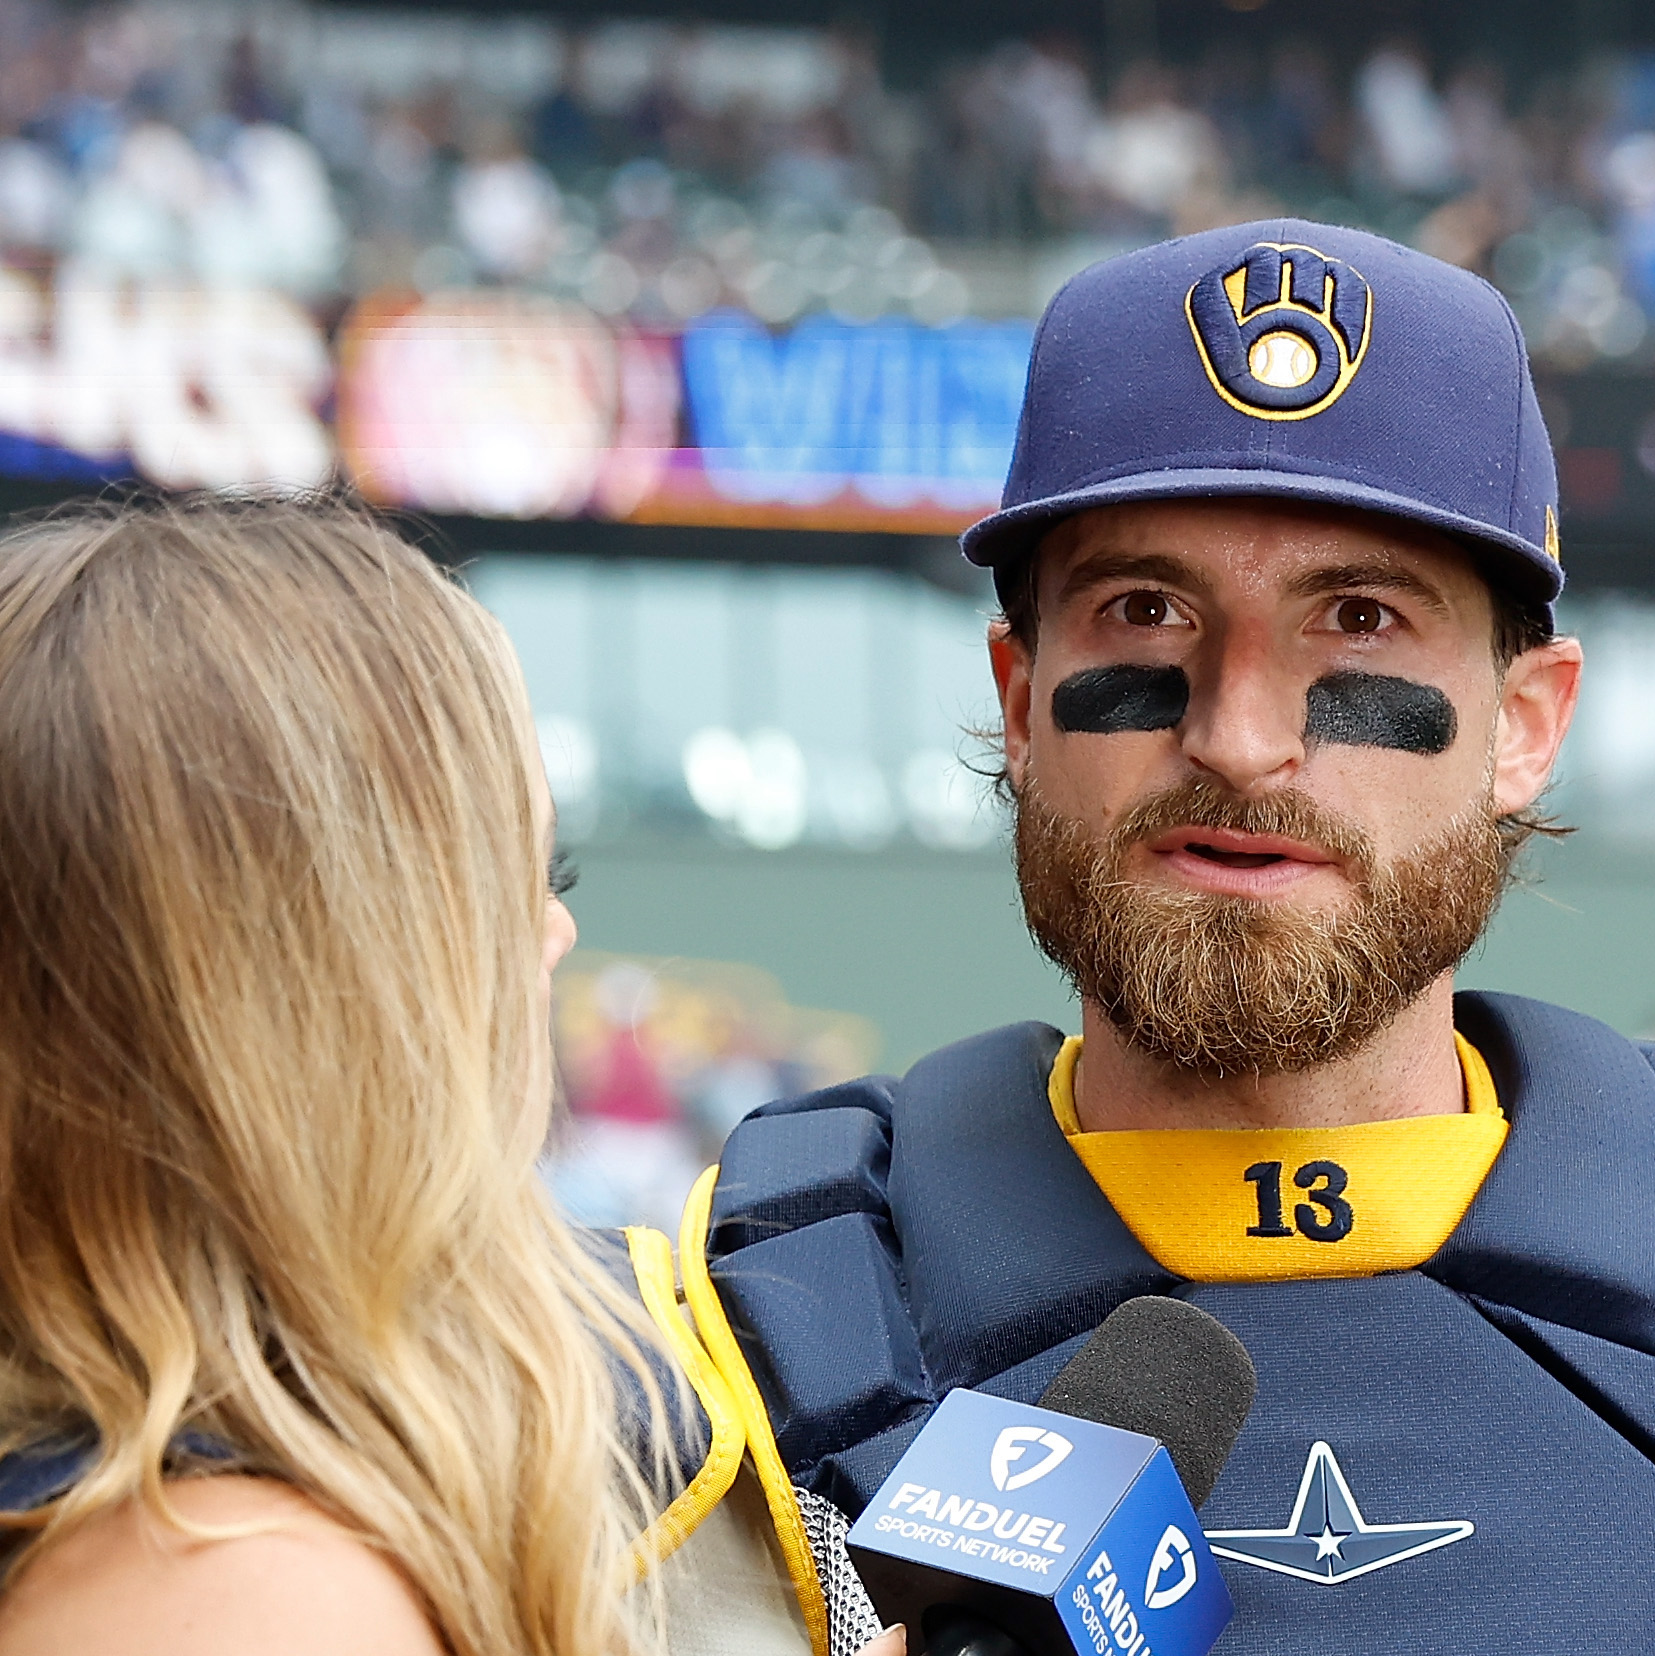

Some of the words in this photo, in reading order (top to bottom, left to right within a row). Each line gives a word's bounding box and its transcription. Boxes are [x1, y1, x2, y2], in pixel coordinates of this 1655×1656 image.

[1244, 1160, 1353, 1242] 13
[874, 1514, 955, 1548] SPORTS
[952, 1534, 1056, 1575] NETWORK
[888, 1482, 1068, 1554] FANDUEL
[1072, 1584, 1109, 1654] SPORTS
